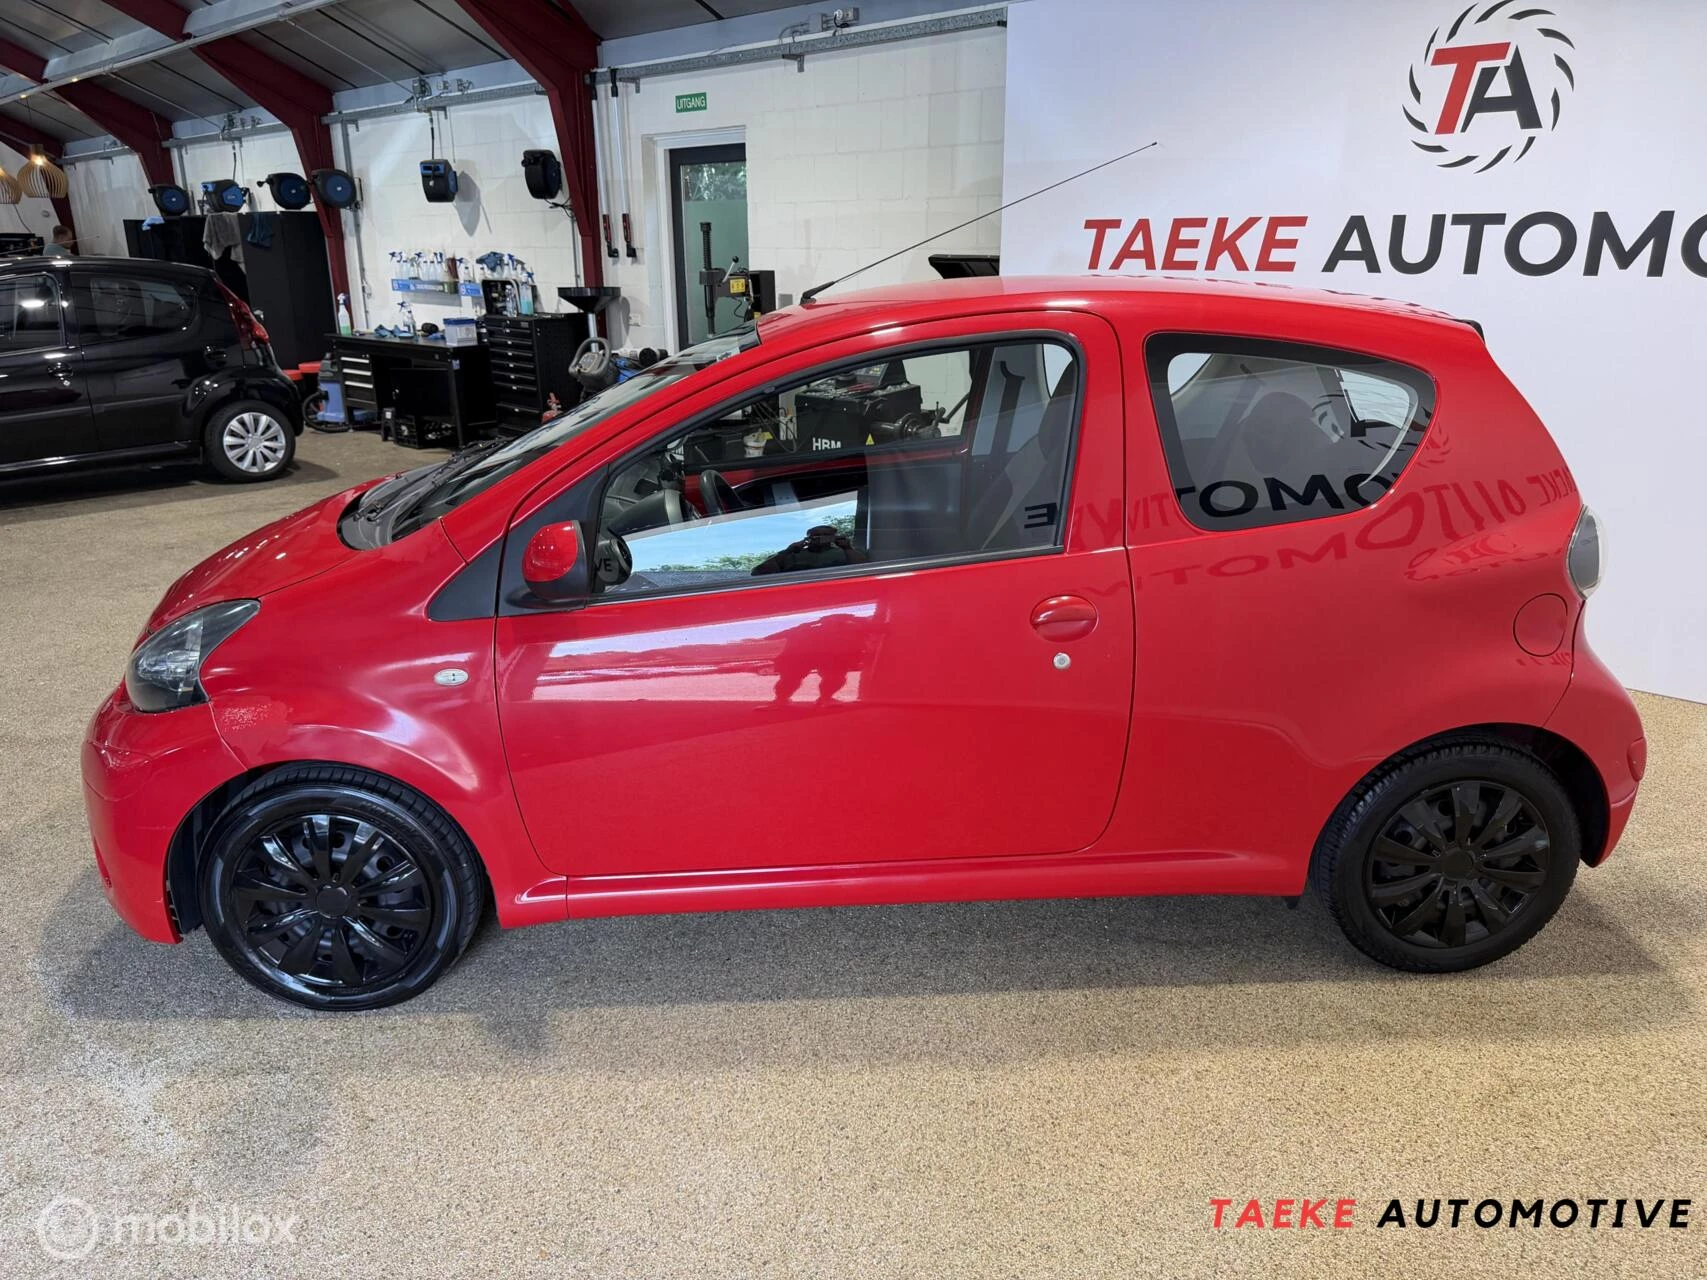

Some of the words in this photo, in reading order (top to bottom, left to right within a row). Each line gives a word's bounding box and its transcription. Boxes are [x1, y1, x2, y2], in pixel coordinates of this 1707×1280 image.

[676, 96, 706, 110] UITGANG
[1431, 42, 1542, 135] TA
[1083, 216, 1308, 273] TAEKE
